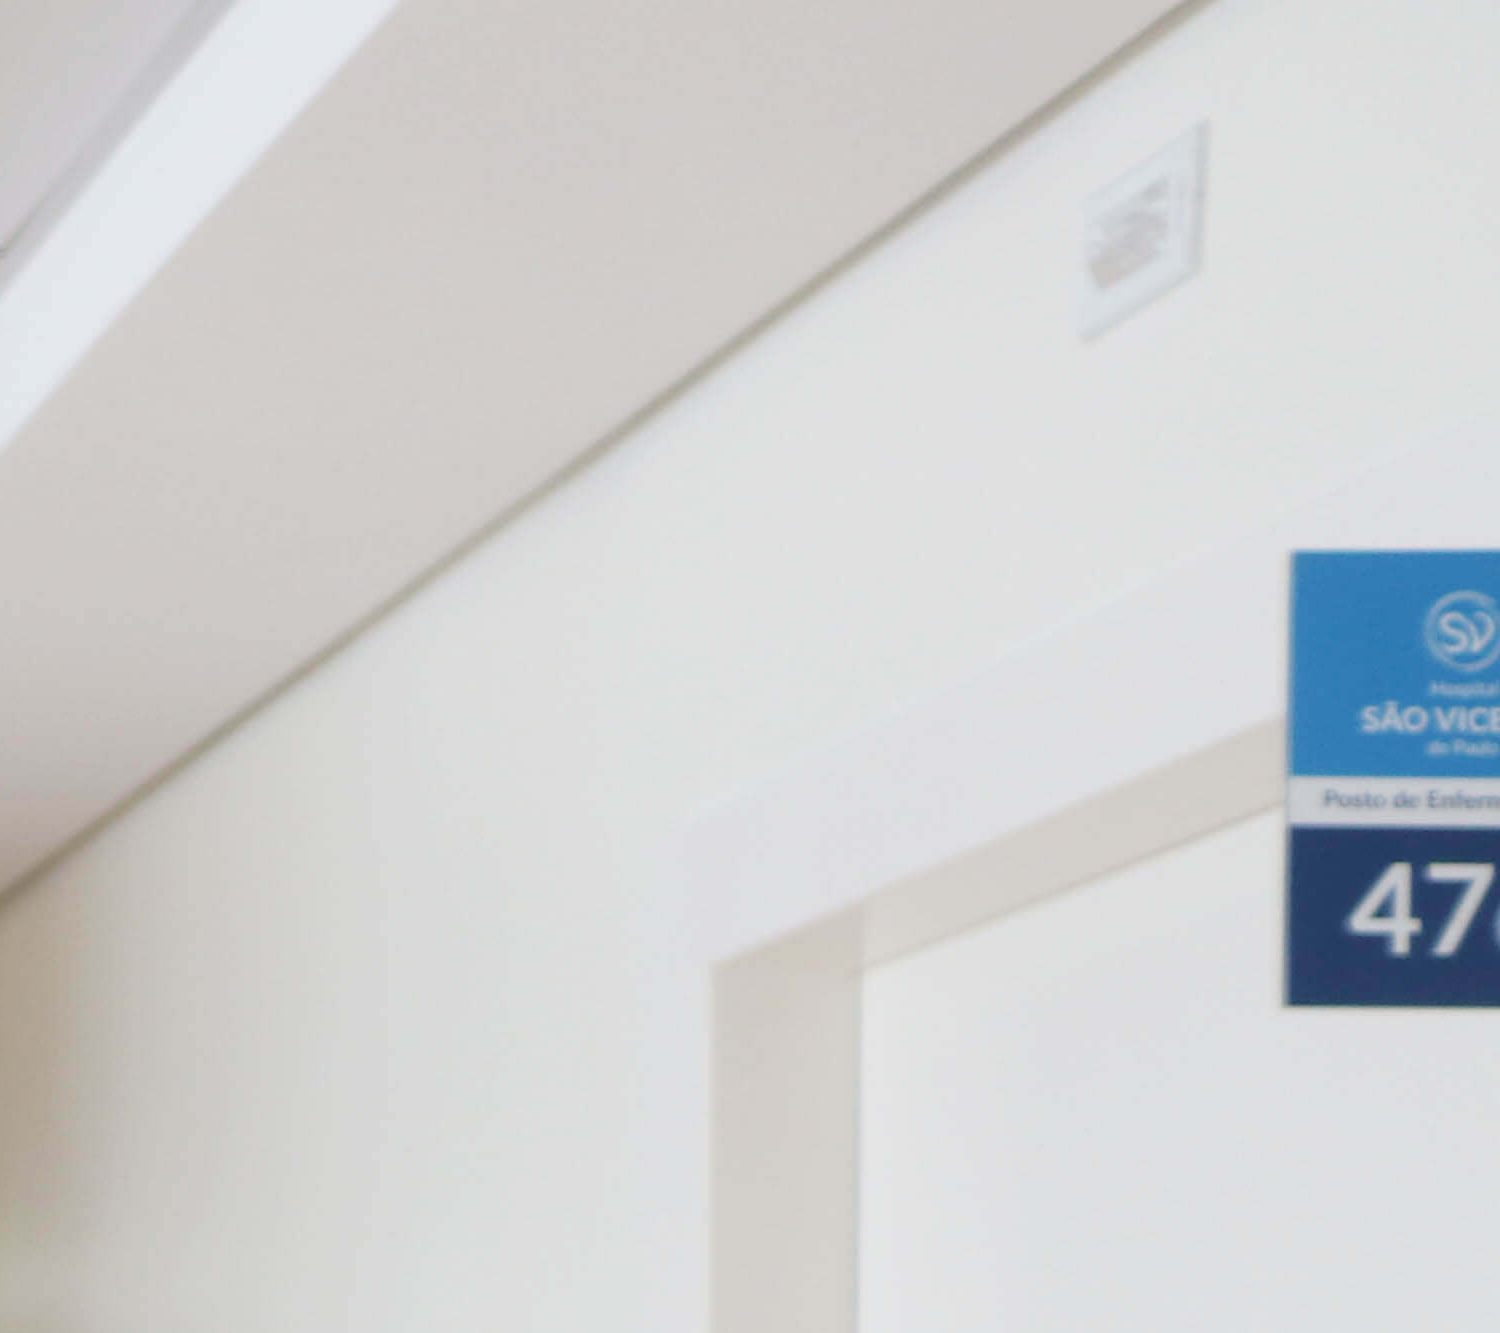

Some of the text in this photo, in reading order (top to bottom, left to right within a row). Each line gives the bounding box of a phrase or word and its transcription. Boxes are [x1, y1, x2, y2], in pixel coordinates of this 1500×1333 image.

[1362, 700, 1430, 734] SÃO
[1323, 788, 1387, 808] Posto
[1393, 789, 1419, 808] de
[1346, 861, 1500, 957] 47
